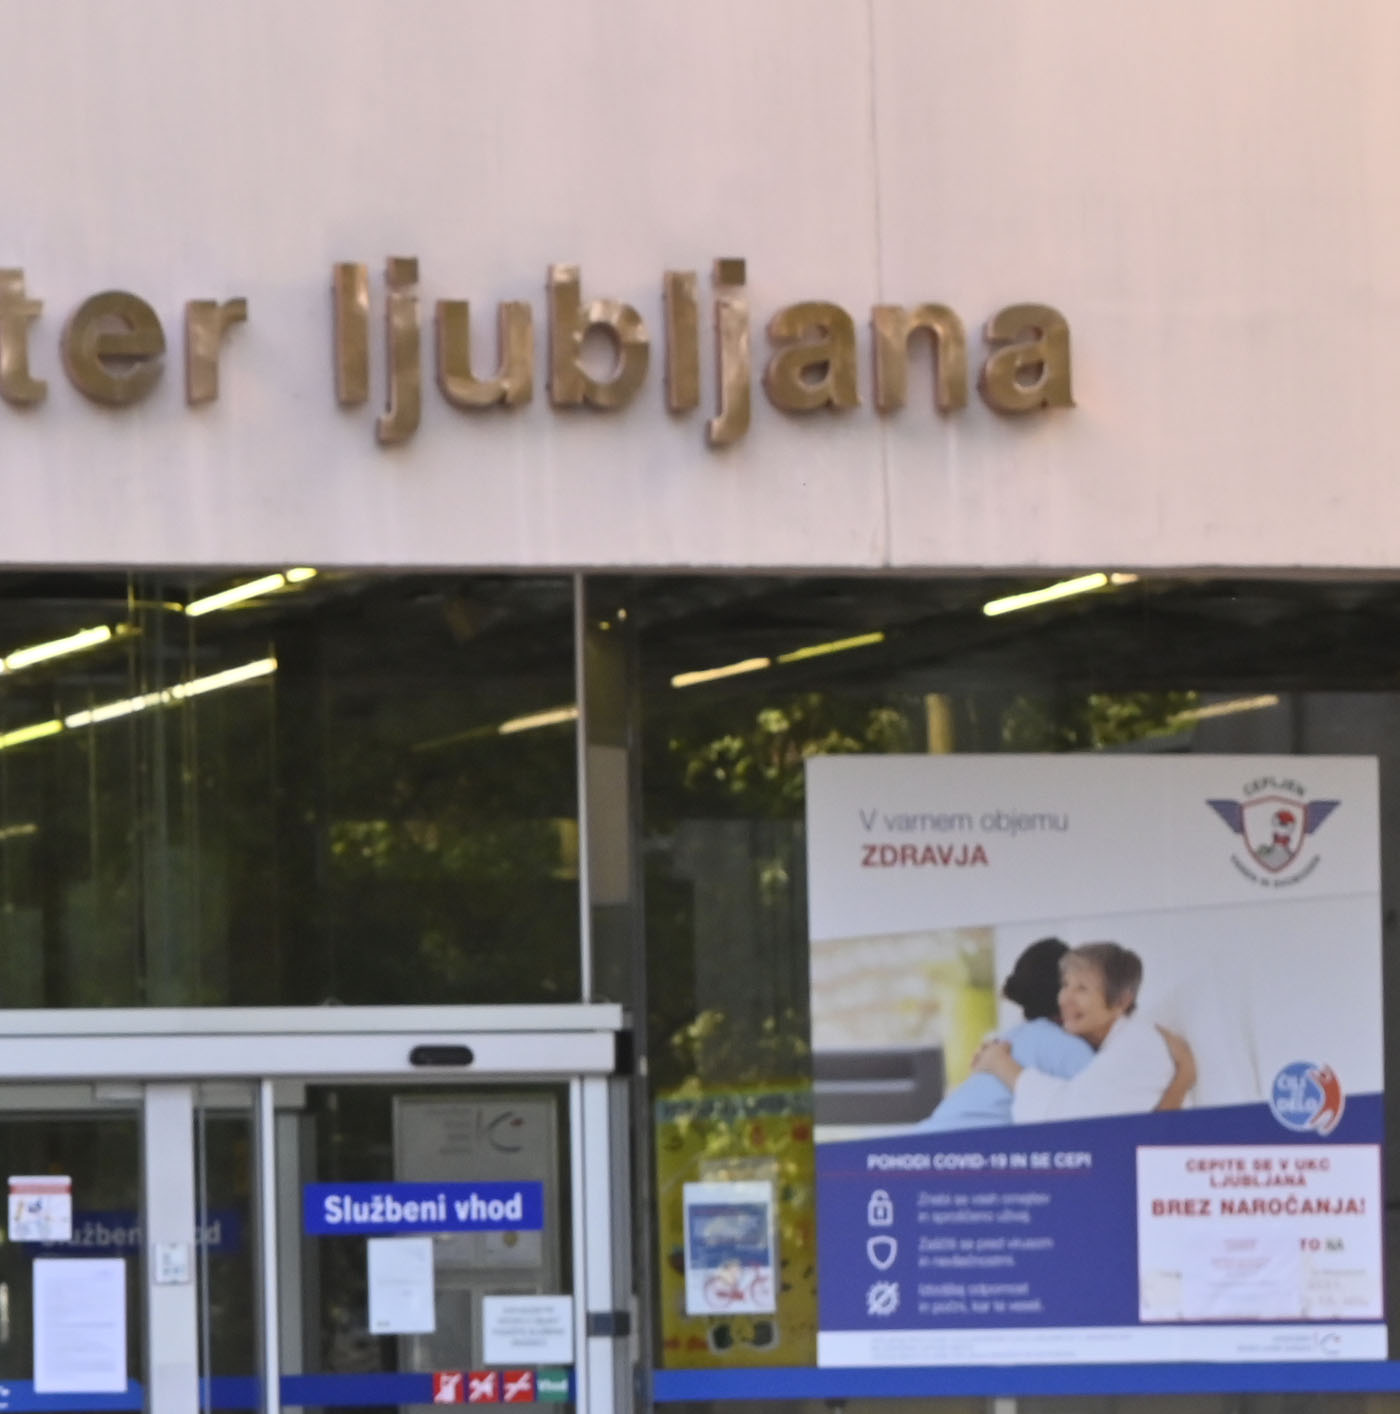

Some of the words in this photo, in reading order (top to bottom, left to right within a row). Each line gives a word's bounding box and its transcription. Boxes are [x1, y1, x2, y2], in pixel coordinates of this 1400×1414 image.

[330, 255, 1077, 447] ljubljana
[858, 809, 878, 832] V
[860, 843, 990, 868] ZDRAVJA
[1186, 1158, 1246, 1173] CEPITE
[1253, 1157, 1273, 1172] SE
[1278, 1157, 1290, 1171] V
[1210, 1174, 1307, 1189] LJUBLJANA
[323, 1193, 447, 1225] Službeni
[454, 1191, 523, 1222] vhod
[1152, 1198, 1212, 1217] BREZ
[1220, 1193, 1366, 1217] NAROČANJA!
